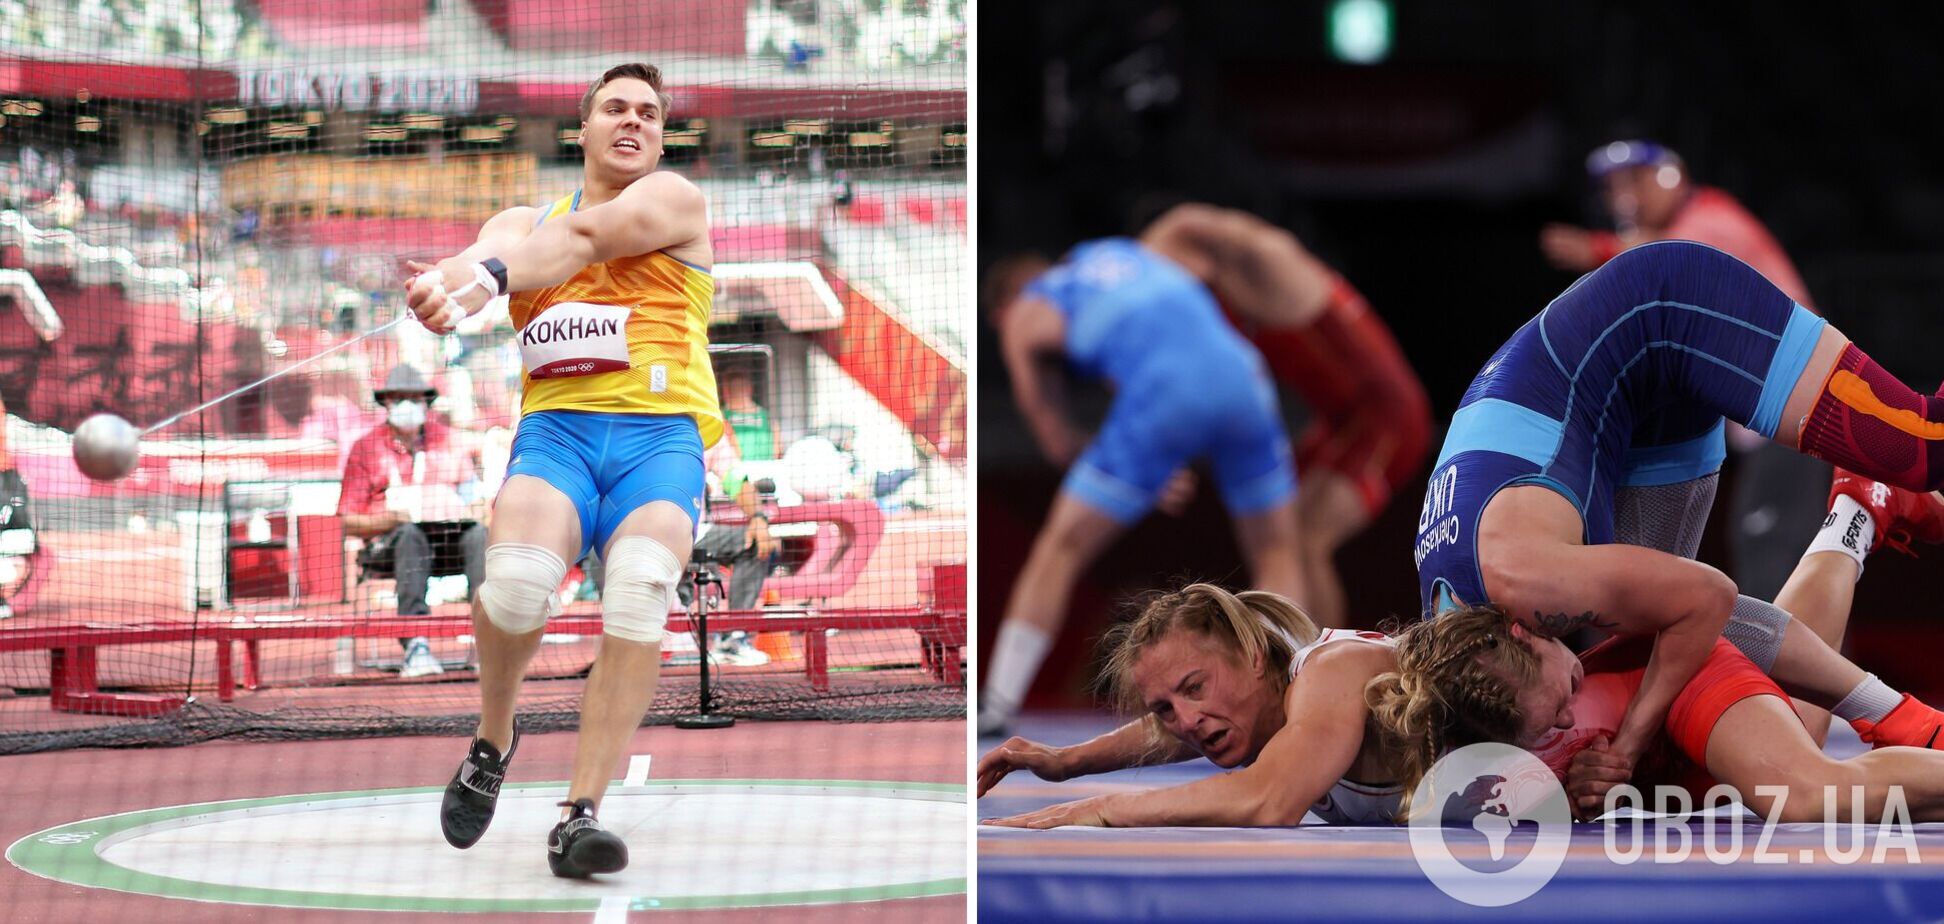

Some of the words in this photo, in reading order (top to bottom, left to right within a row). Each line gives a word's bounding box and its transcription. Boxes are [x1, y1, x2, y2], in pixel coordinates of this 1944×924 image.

[238, 70, 372, 111] TOKYO
[378, 76, 480, 115] 2020
[523, 317, 618, 346] KOKHAN
[1419, 464, 1457, 535] UKR
